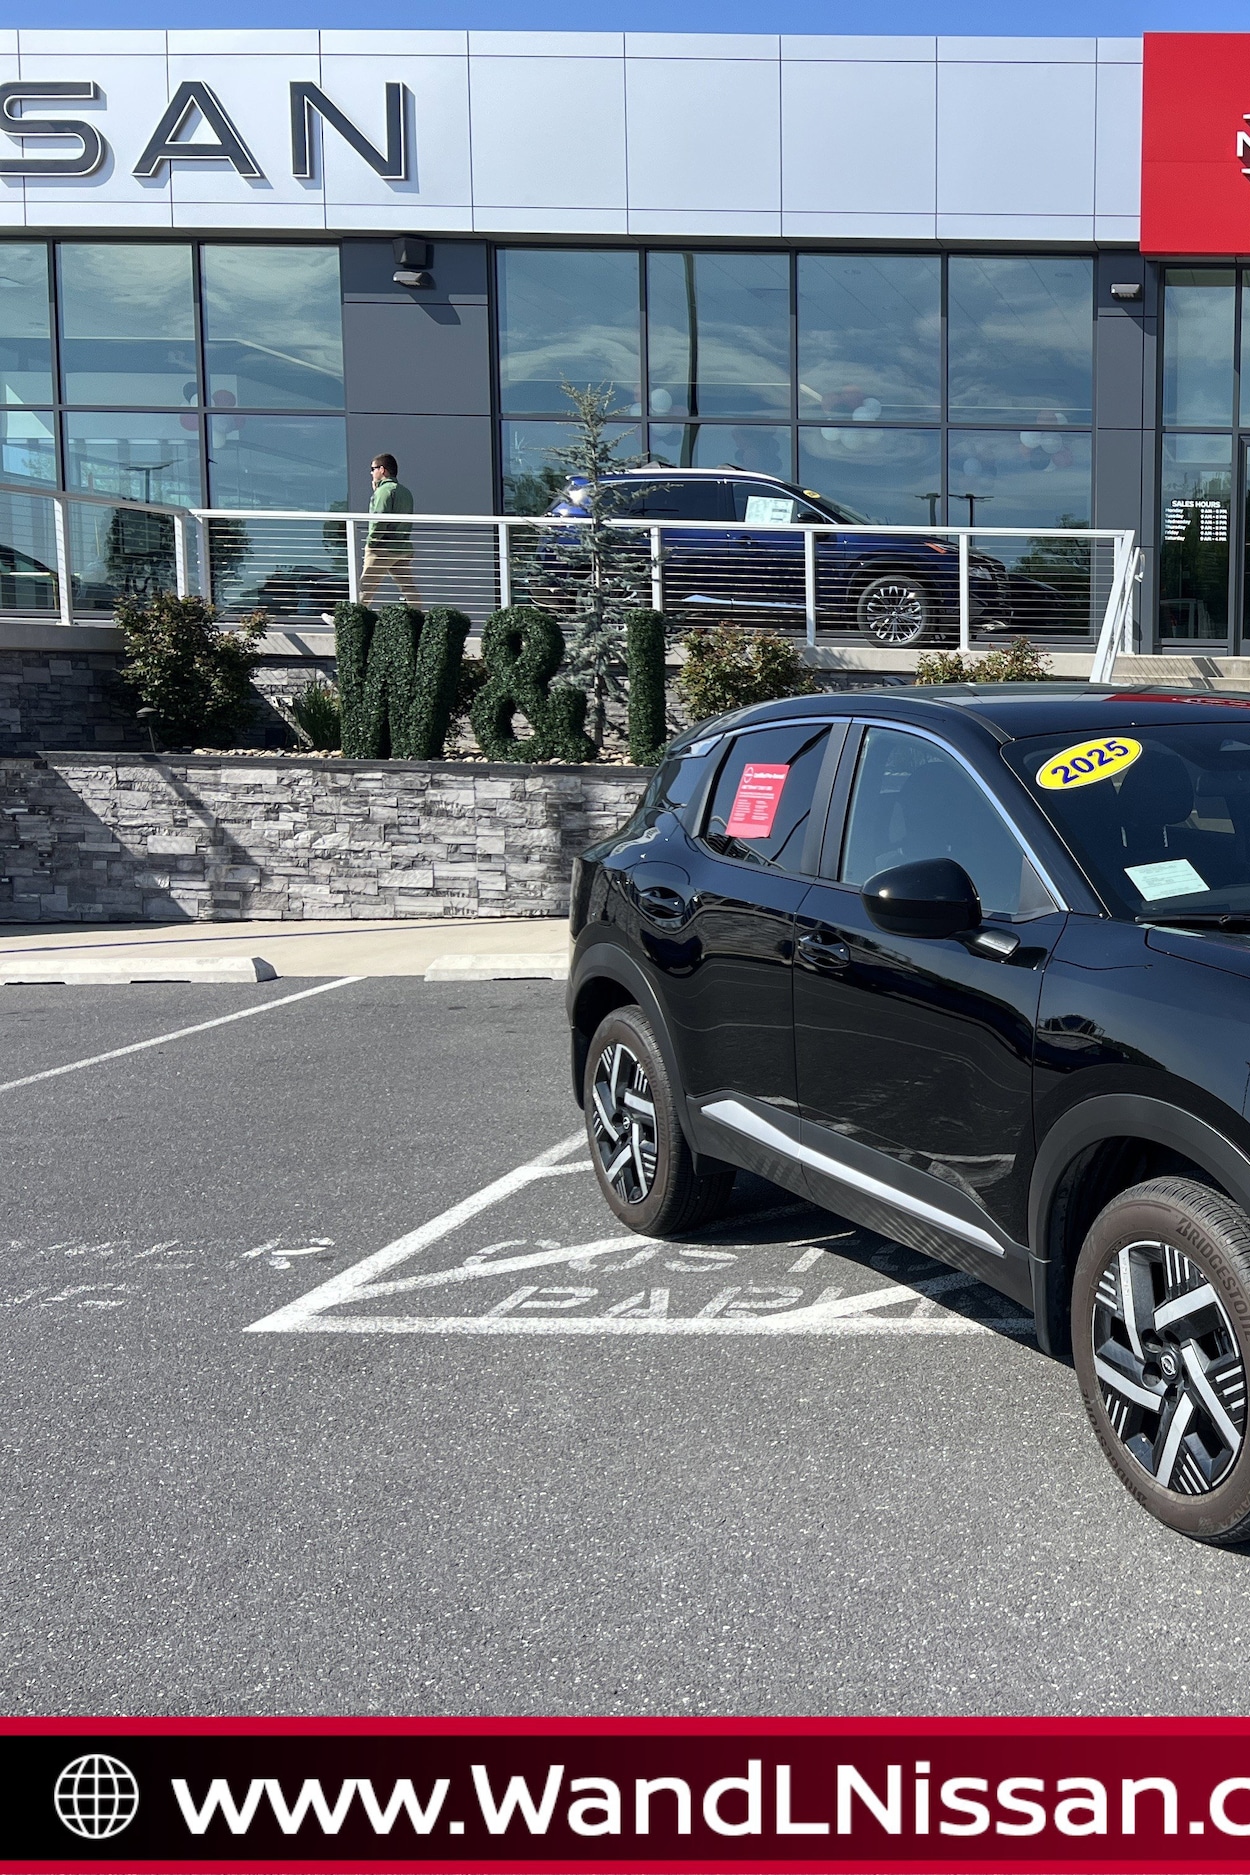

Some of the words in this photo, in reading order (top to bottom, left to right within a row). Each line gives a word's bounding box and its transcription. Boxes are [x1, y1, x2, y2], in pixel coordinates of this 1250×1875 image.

[0, 80, 408, 180] SAN
[1171, 500, 1194, 508] SALES
[1195, 500, 1221, 508] HOURS
[1050, 740, 1129, 785] 2025
